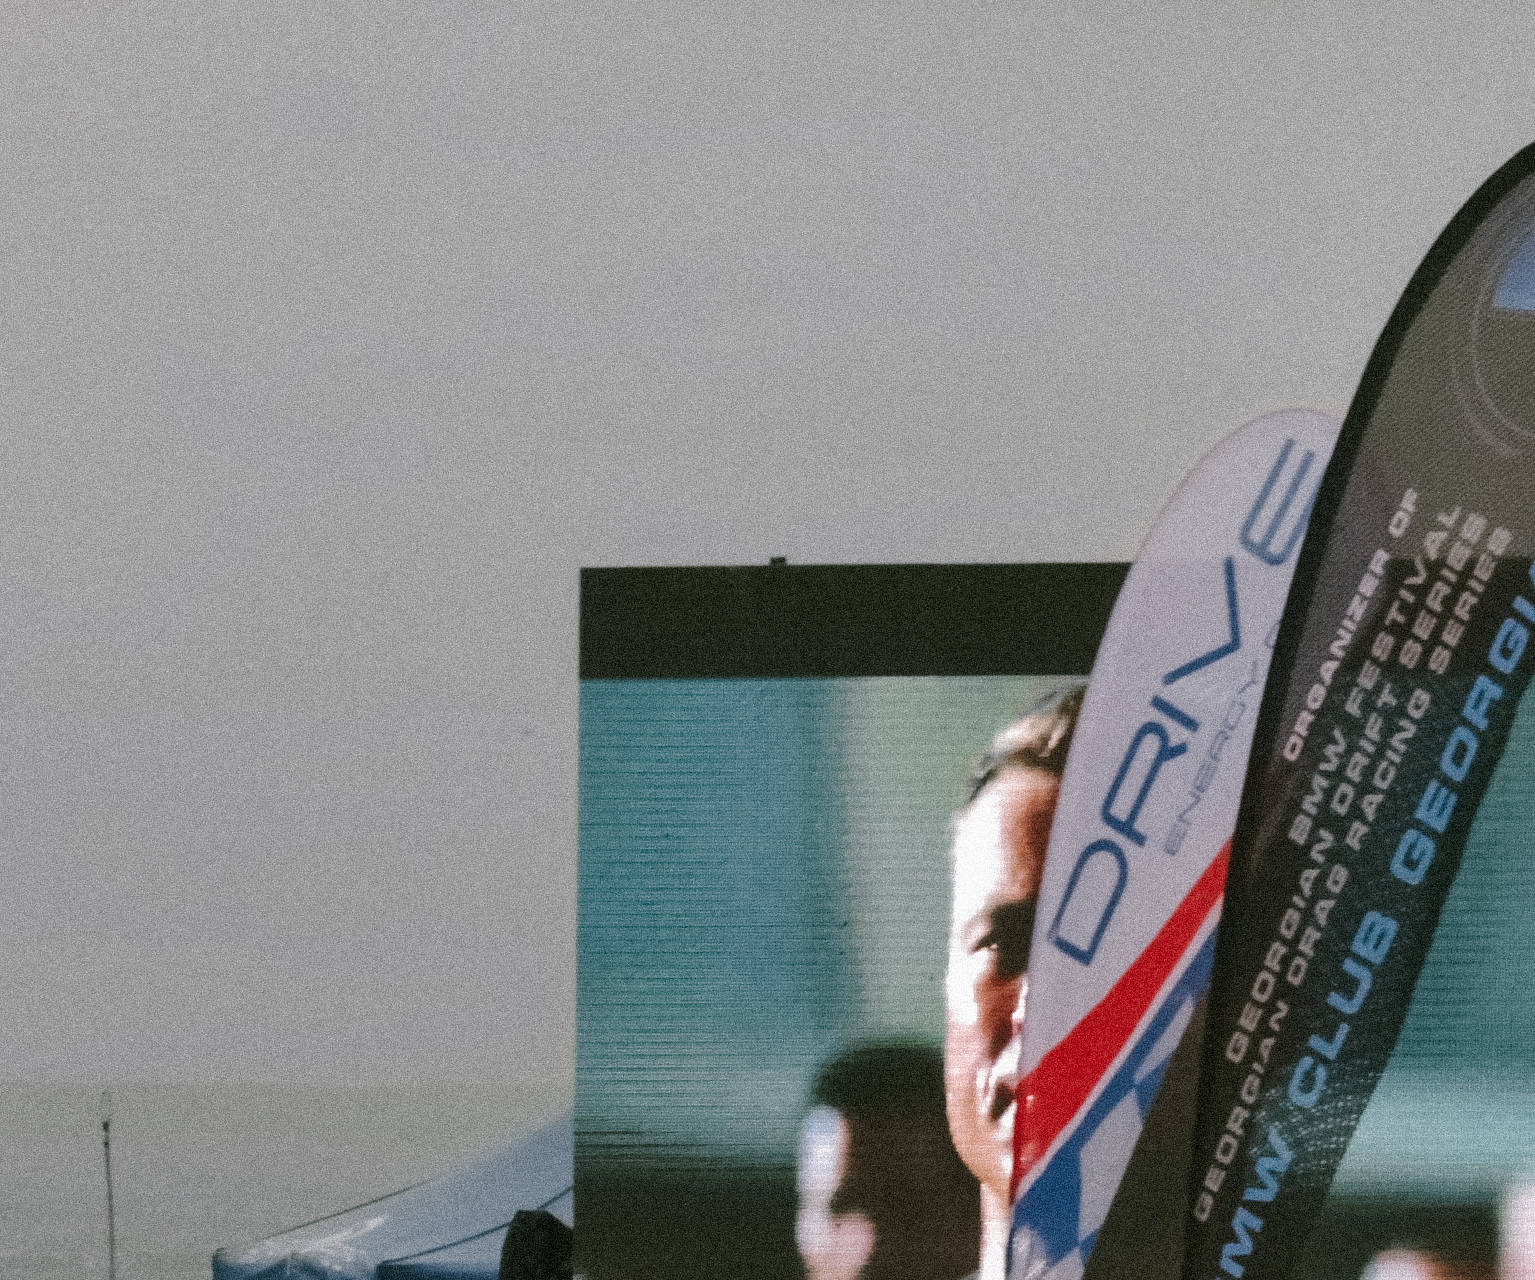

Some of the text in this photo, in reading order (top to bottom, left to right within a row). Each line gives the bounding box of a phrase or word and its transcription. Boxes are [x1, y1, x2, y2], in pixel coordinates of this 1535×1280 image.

[1048, 439, 1316, 966] DRIVE
[1194, 525, 1514, 1222] GEORGIAN DRAG RACING SERIES
[1225, 512, 1488, 1063] GEORGIAN DRIFT SERIES
[1283, 486, 1419, 762] ORGANIZER OF
[1288, 727, 1347, 846] BMW
[1288, 910, 1400, 1108] CLUB
[1389, 560, 1535, 885] GEORGI
